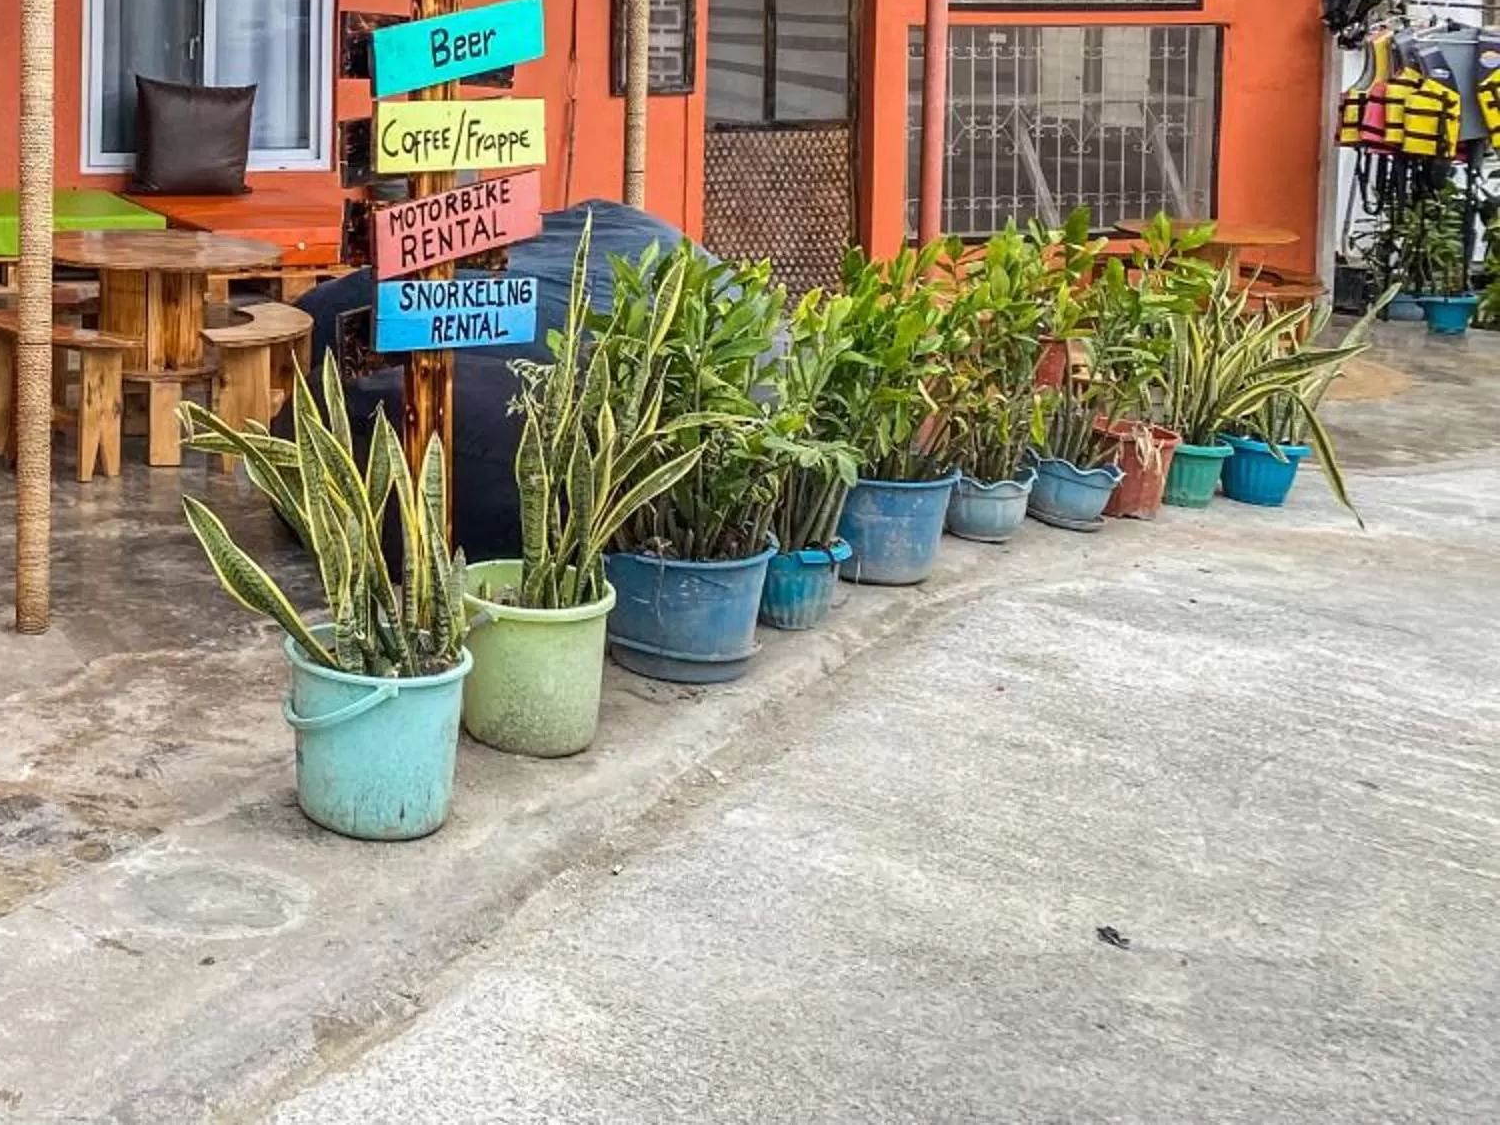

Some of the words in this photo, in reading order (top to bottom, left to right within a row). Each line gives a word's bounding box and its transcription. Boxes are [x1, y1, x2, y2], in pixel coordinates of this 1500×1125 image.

[430, 27, 497, 69] Beer
[389, 178, 512, 236] MOTORBIKE
[401, 210, 507, 268] RENTAL
[399, 280, 533, 312] SNORKELING
[431, 311, 509, 343] RENTAL
